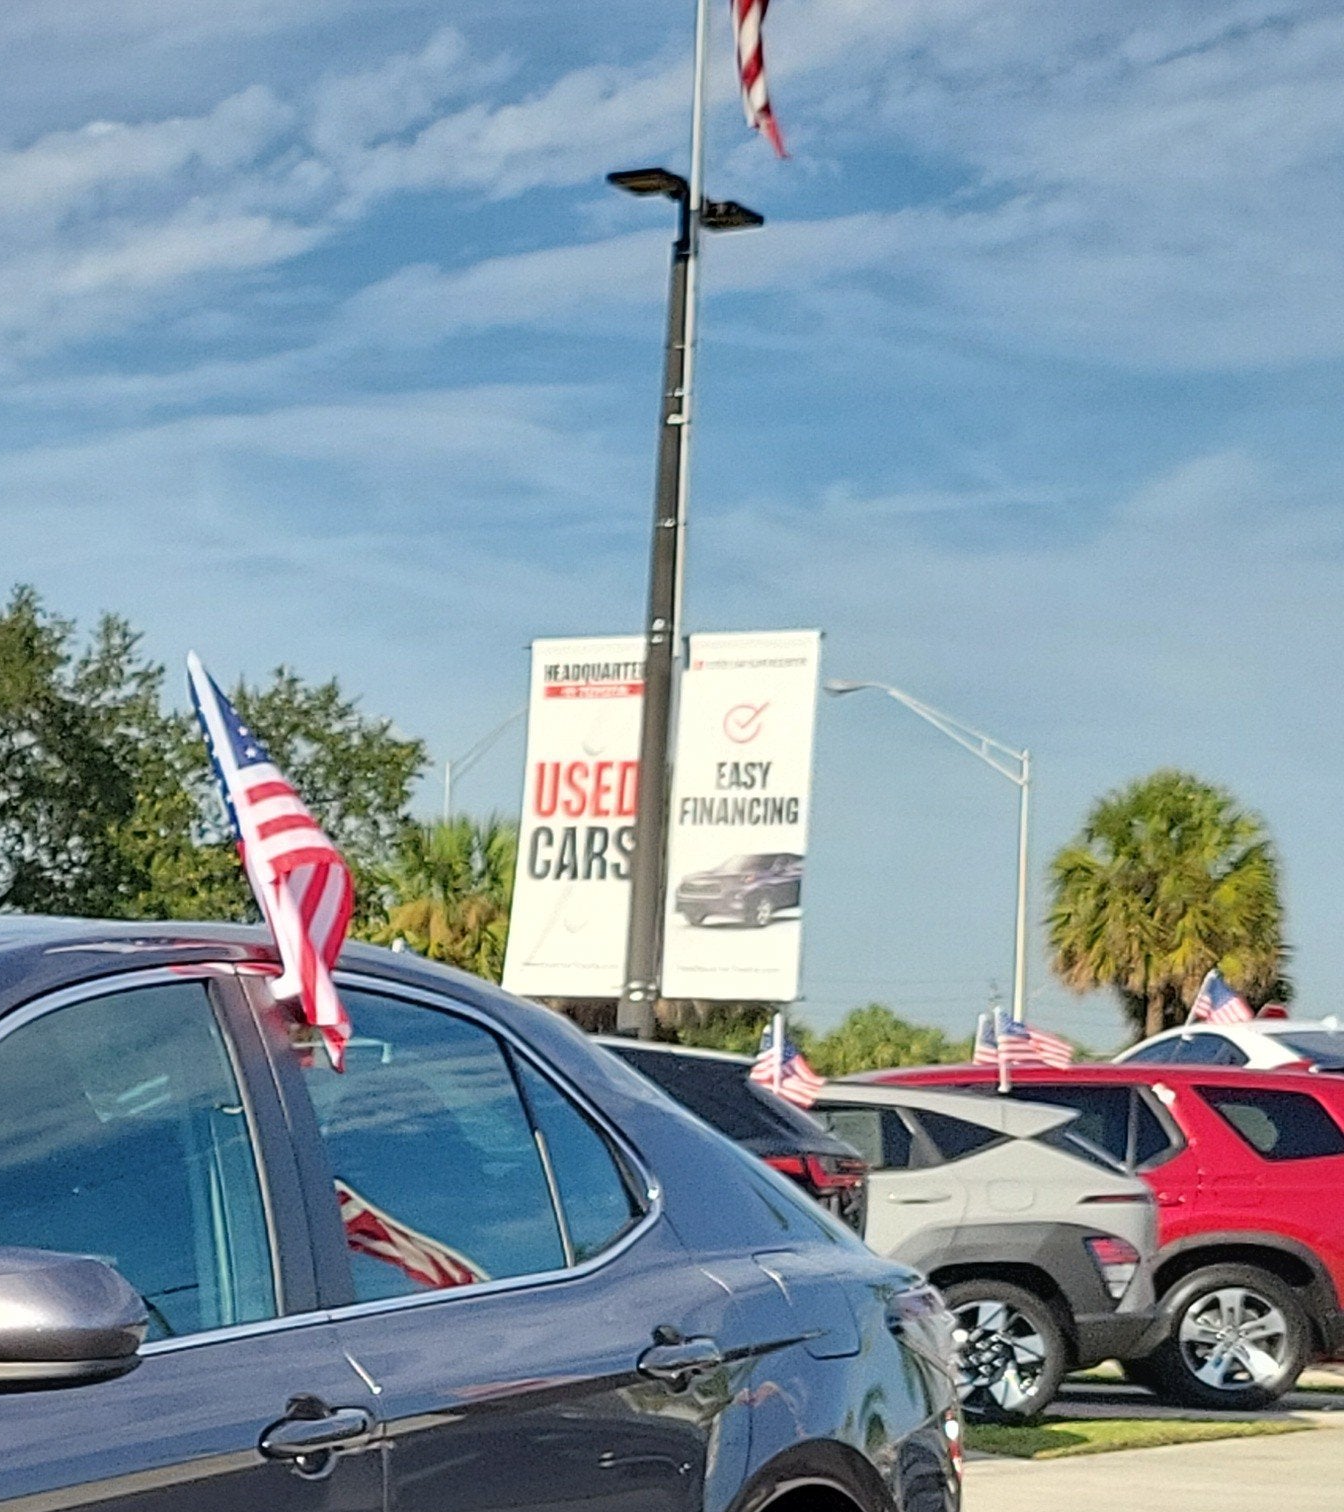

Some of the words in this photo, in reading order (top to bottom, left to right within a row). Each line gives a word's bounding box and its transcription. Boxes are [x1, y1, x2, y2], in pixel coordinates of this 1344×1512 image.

[543, 661, 645, 682] HEADQUARTE
[534, 760, 640, 818] USED
[715, 761, 773, 790] EASY
[679, 796, 800, 826] FINANCING
[528, 826, 638, 881] CARS
